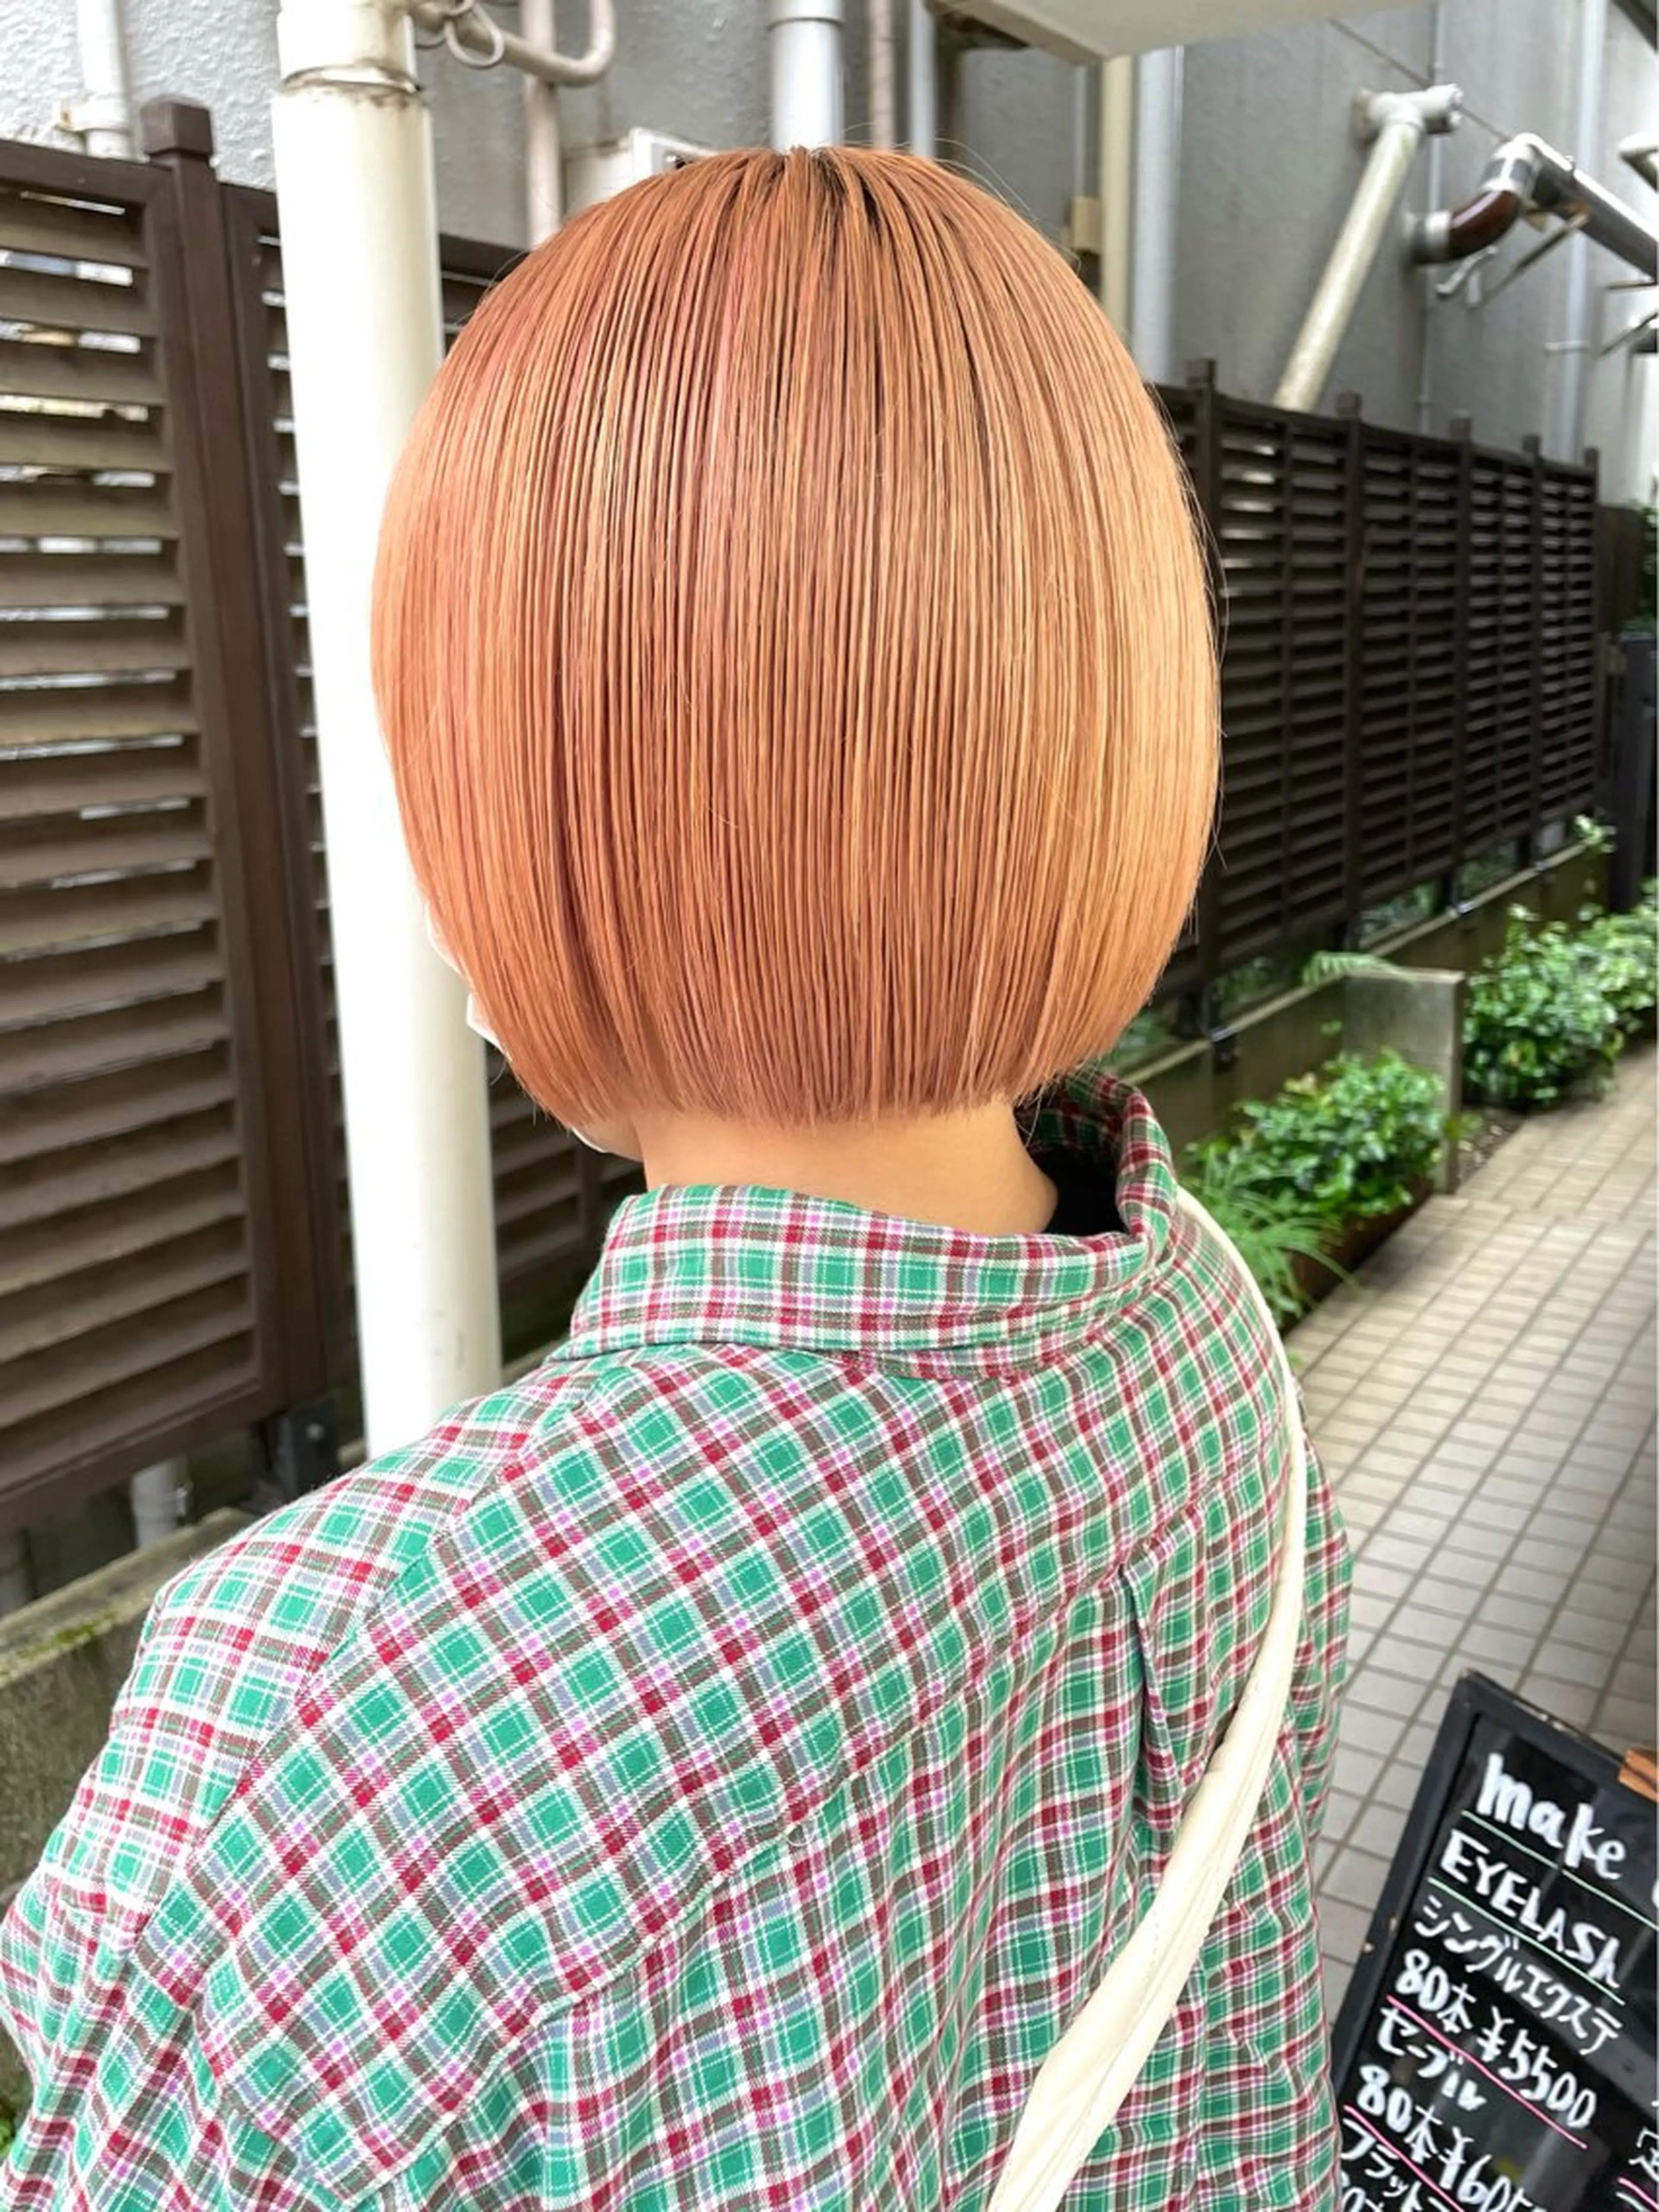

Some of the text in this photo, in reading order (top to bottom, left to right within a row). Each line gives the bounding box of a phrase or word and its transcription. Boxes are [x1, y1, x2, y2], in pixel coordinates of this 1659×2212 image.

[1476, 1752, 1627, 1880] make
[1414, 1894, 1623, 2056] シングルエクステ
[1377, 2007, 1487, 2111] セーブル
